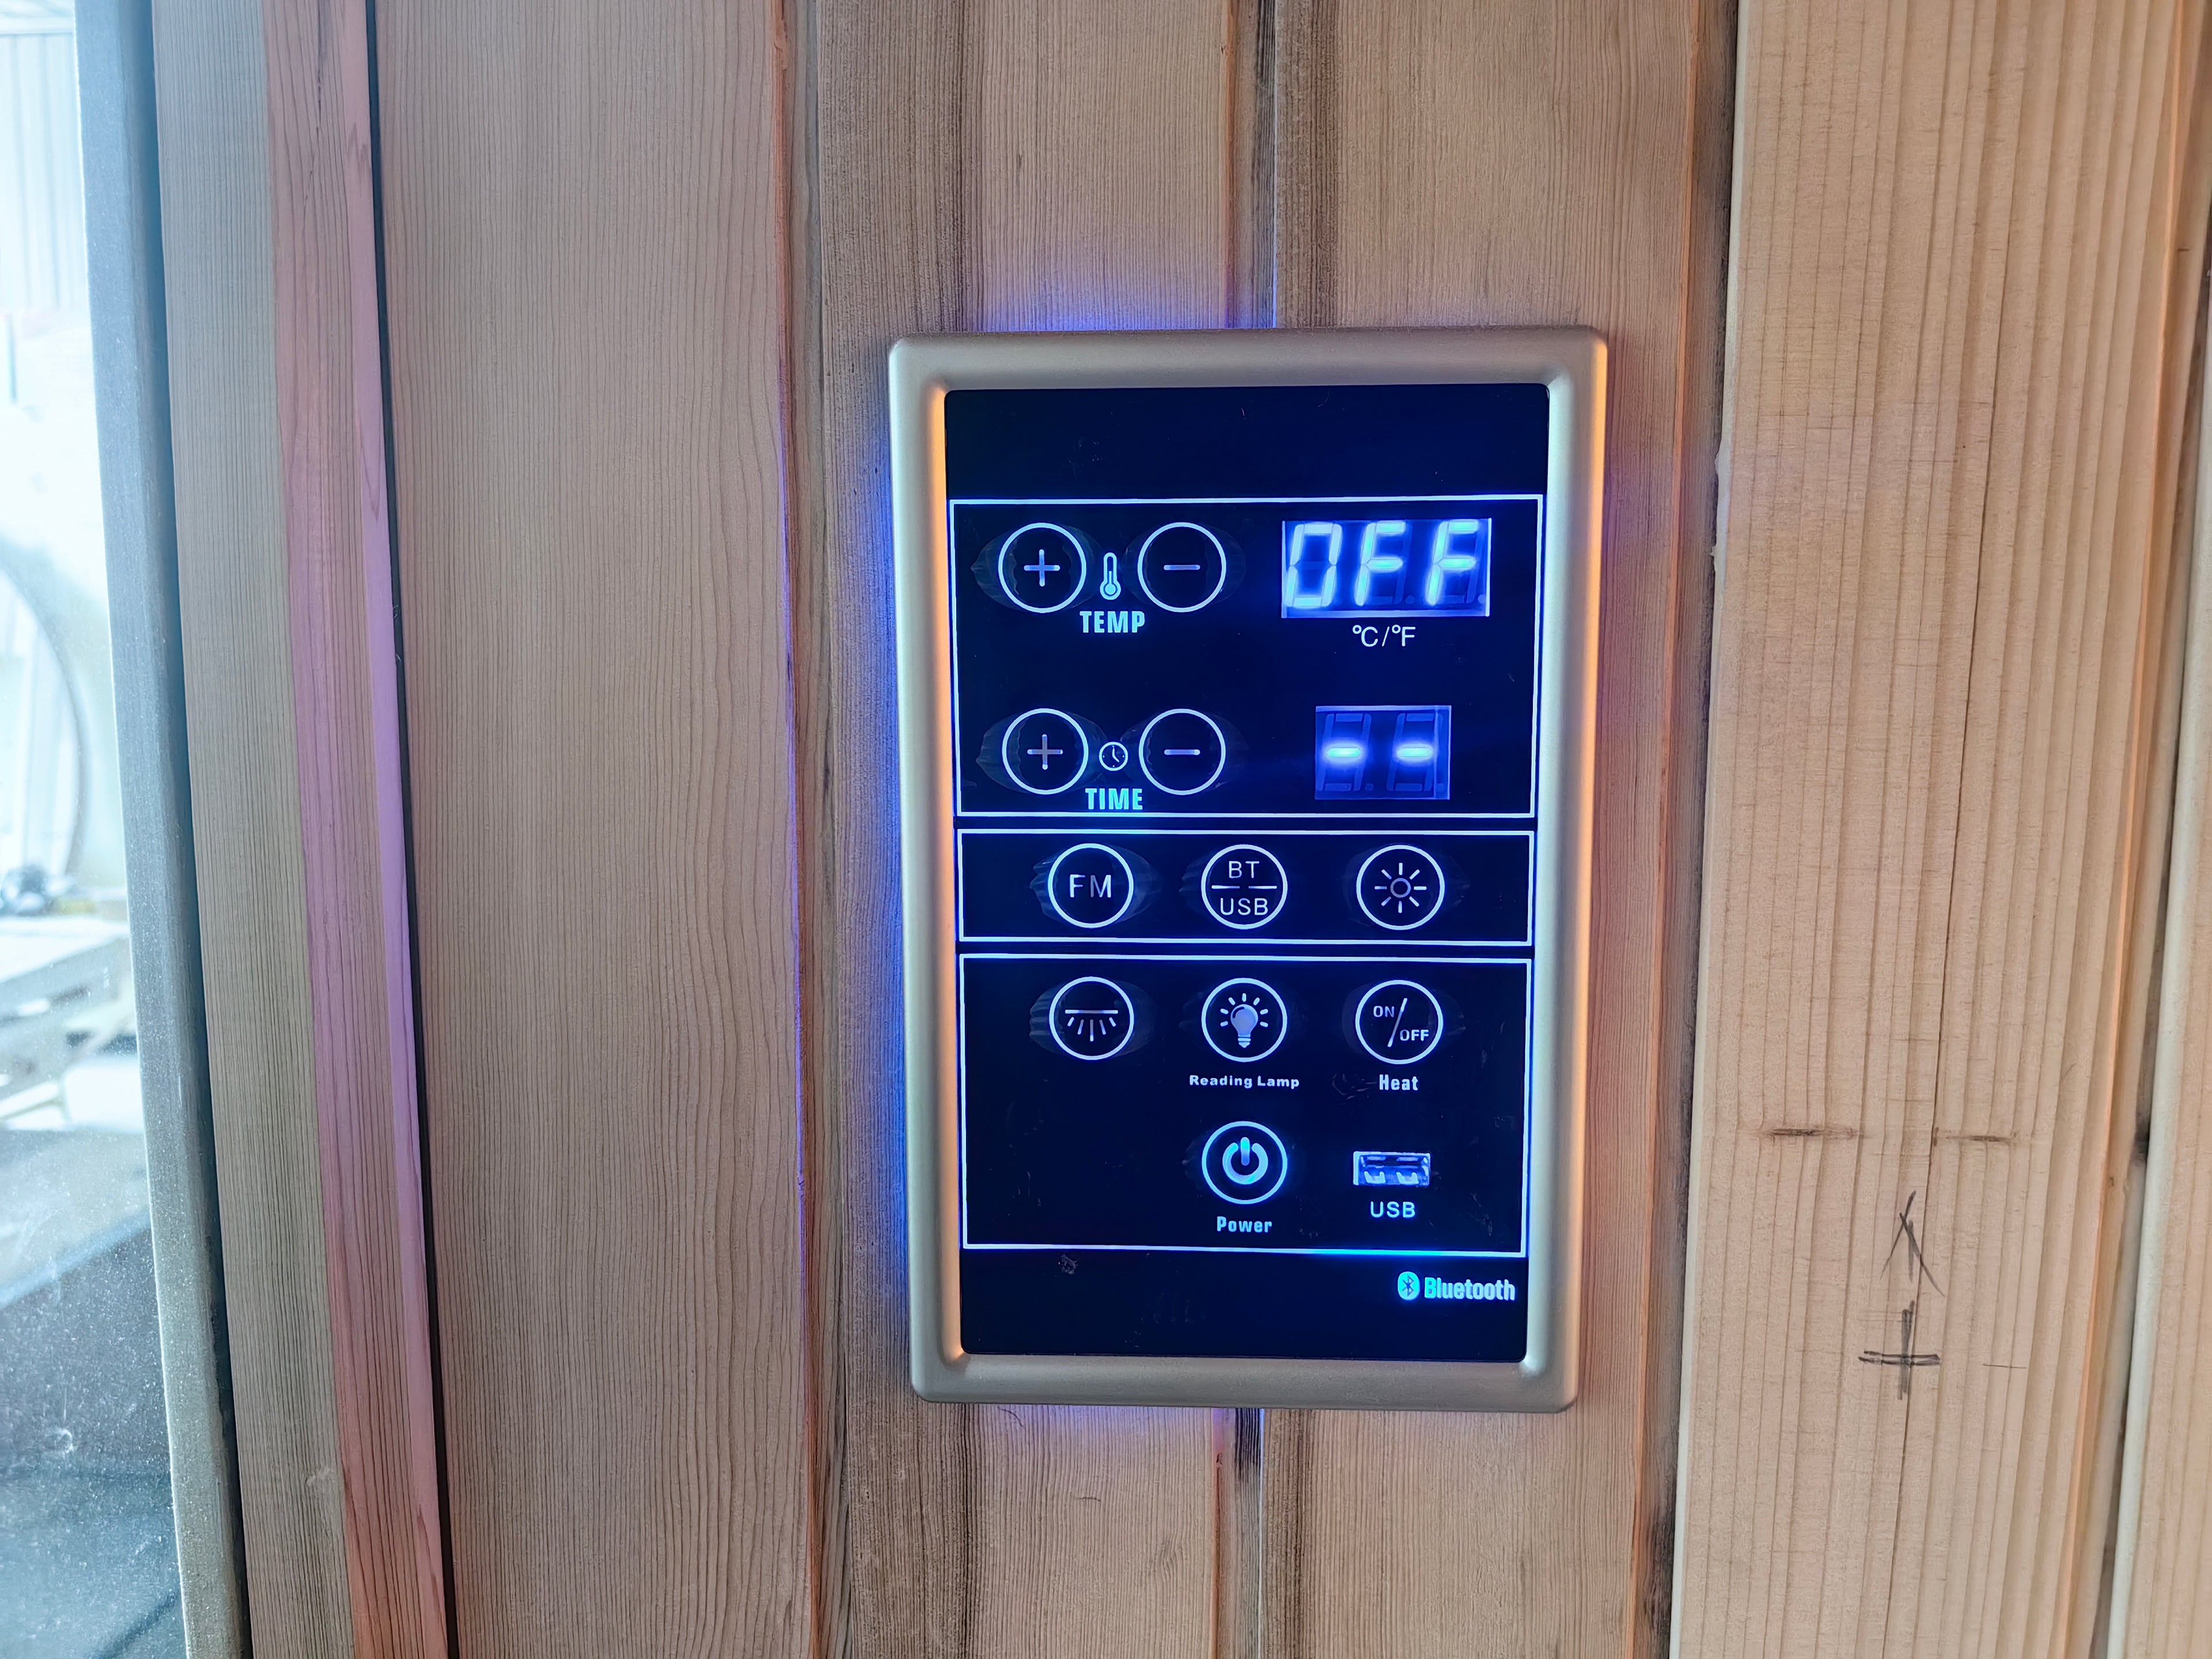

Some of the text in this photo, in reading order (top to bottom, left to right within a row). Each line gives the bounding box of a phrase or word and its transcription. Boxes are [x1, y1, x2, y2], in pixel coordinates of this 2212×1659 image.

[1079, 610, 1146, 634] TEMP
[1085, 787, 1143, 810] TIME
[1228, 860, 1261, 880] BT
[1069, 873, 1112, 899] FM
[1219, 897, 1269, 917] USB
[1372, 1005, 1395, 1018] ON
[1399, 1028, 1430, 1042] OFF
[1188, 1074, 1300, 1091] Reading Lamp
[1378, 1074, 1419, 1092] Heat
[1369, 1200, 1417, 1219] USB
[1216, 1215, 1272, 1234] Power
[1423, 1277, 1516, 1302] Bluetooth
